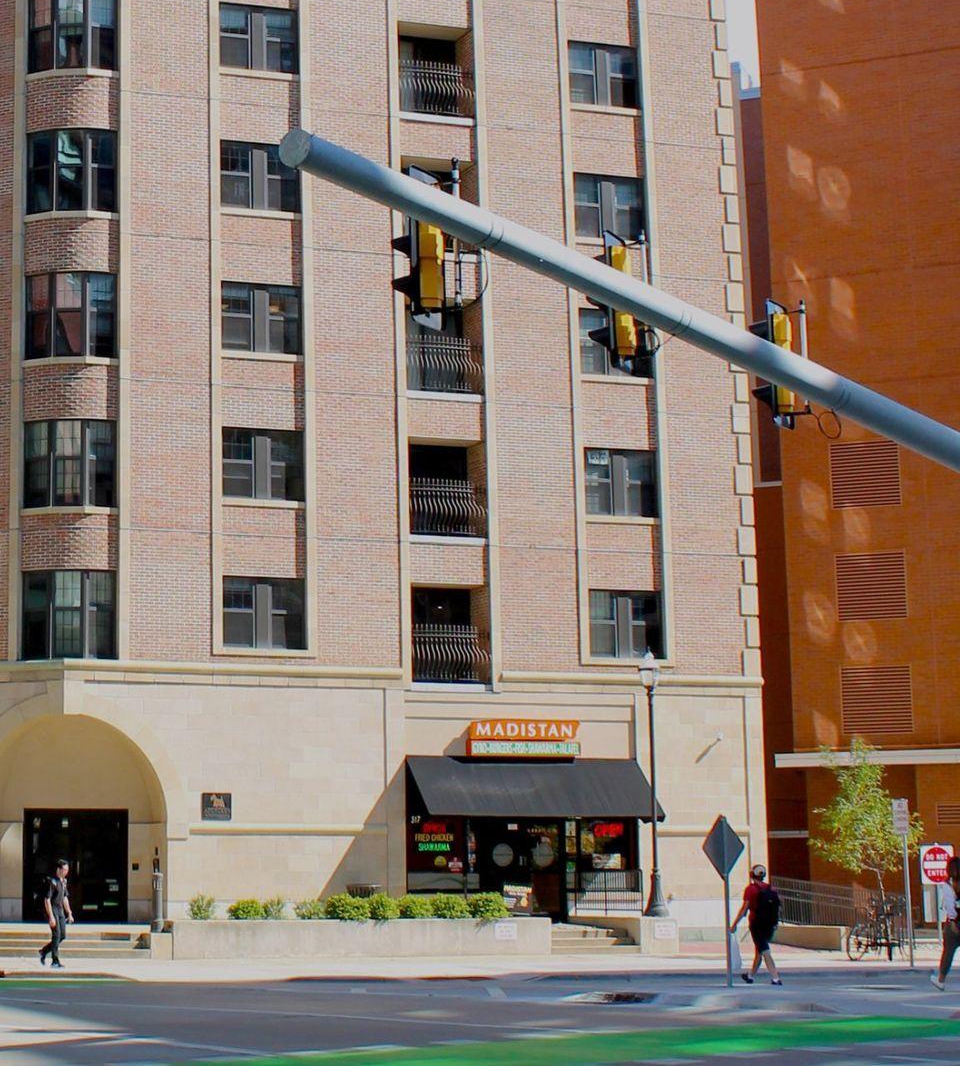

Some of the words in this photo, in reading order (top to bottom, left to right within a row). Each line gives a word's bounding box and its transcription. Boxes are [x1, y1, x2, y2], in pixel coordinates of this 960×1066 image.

[475, 722, 573, 738] MADISTAN
[414, 832, 430, 842] FRIED
[431, 832, 454, 842] CHICKEN
